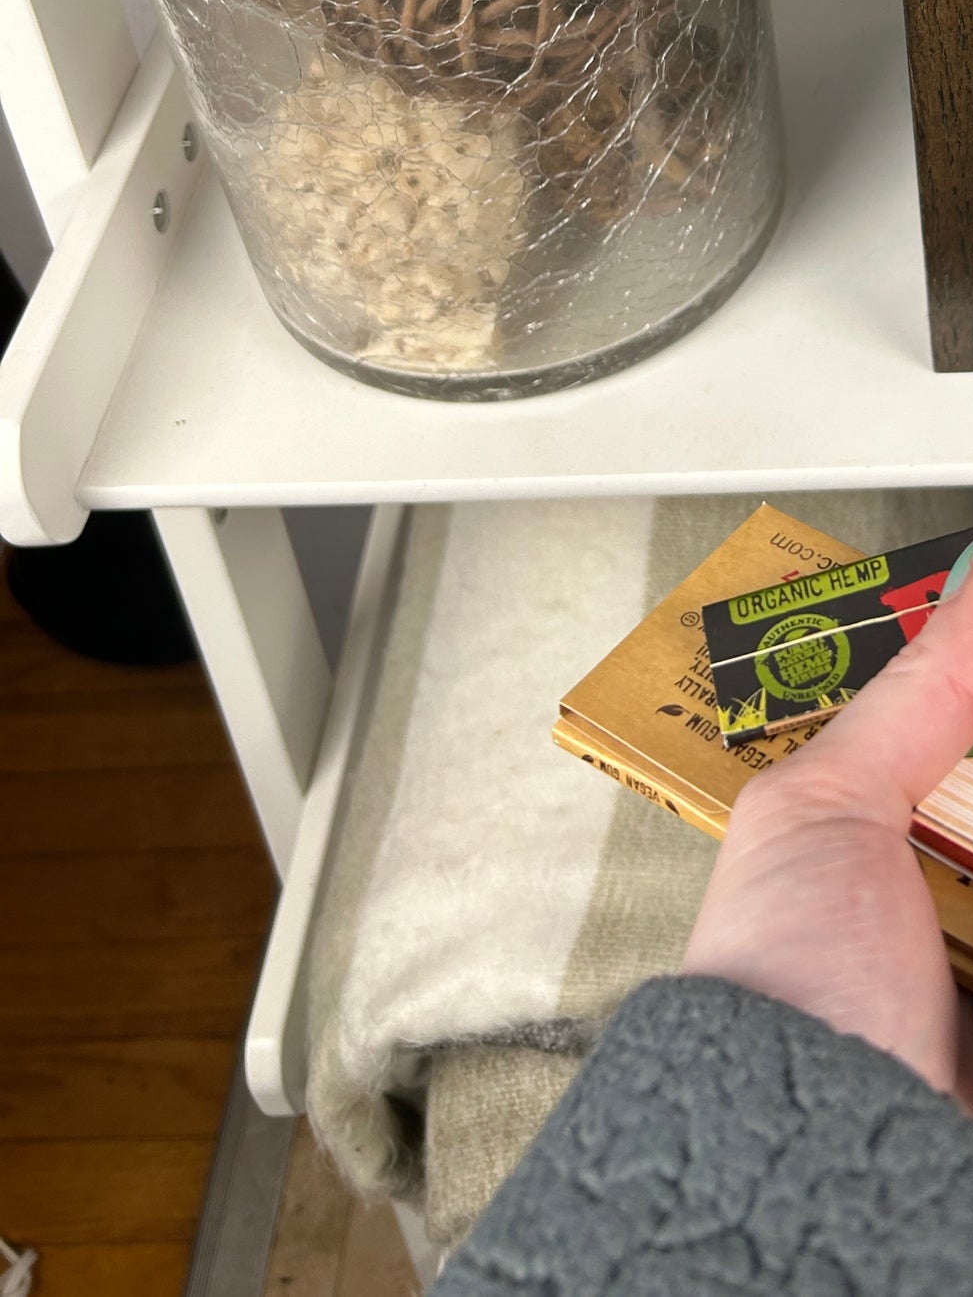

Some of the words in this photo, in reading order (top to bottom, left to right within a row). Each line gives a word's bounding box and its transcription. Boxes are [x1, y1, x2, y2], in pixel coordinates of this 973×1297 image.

[737, 576, 824, 619] ORGANIC
[829, 559, 884, 591] HEMP
[763, 616, 823, 648] AUTHENTIC
[684, 712, 721, 743] GUM
[599, 758, 621, 782] GUM
[626, 773, 661, 804] VEGAN
